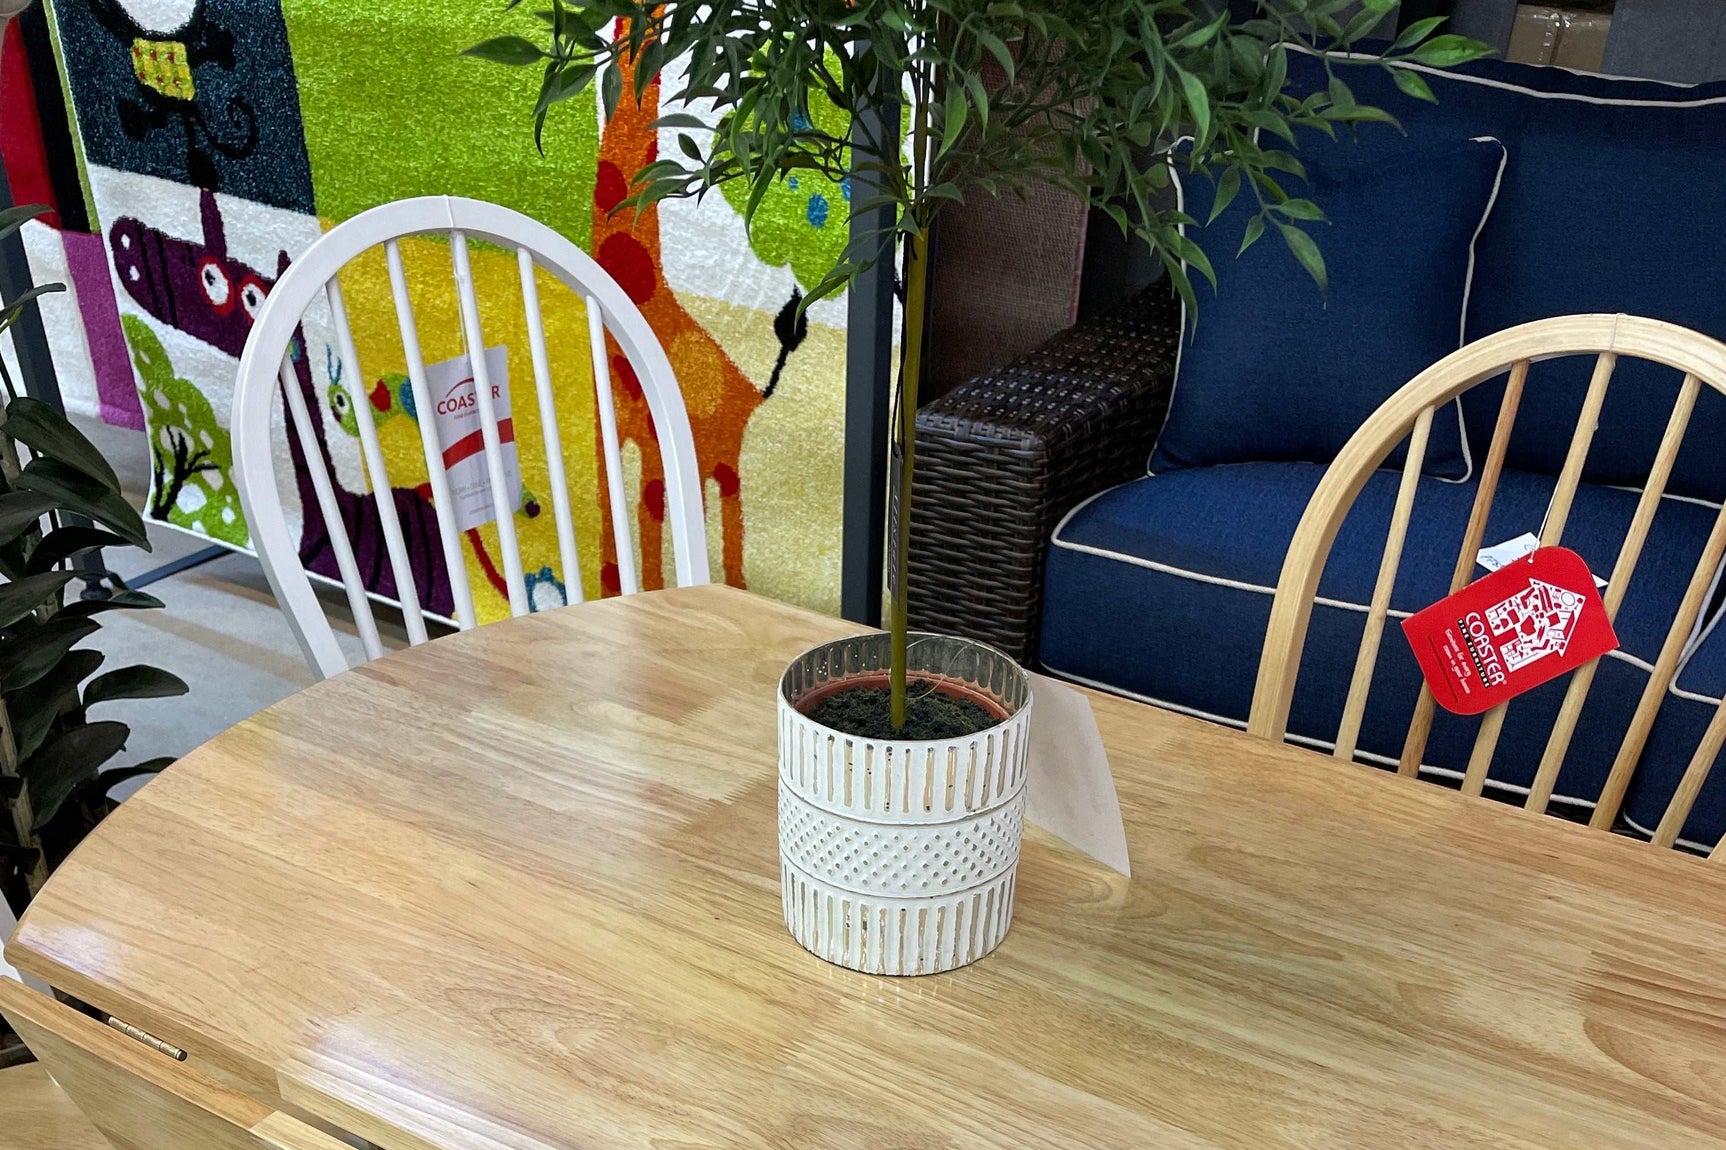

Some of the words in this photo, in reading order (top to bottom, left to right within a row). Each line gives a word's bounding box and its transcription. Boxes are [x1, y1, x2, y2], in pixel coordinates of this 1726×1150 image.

[437, 385, 501, 415] COASR
[1458, 619, 1470, 639] FINE
[1468, 641, 1491, 688] FURNITURE
[1466, 612, 1505, 686] COASTER
